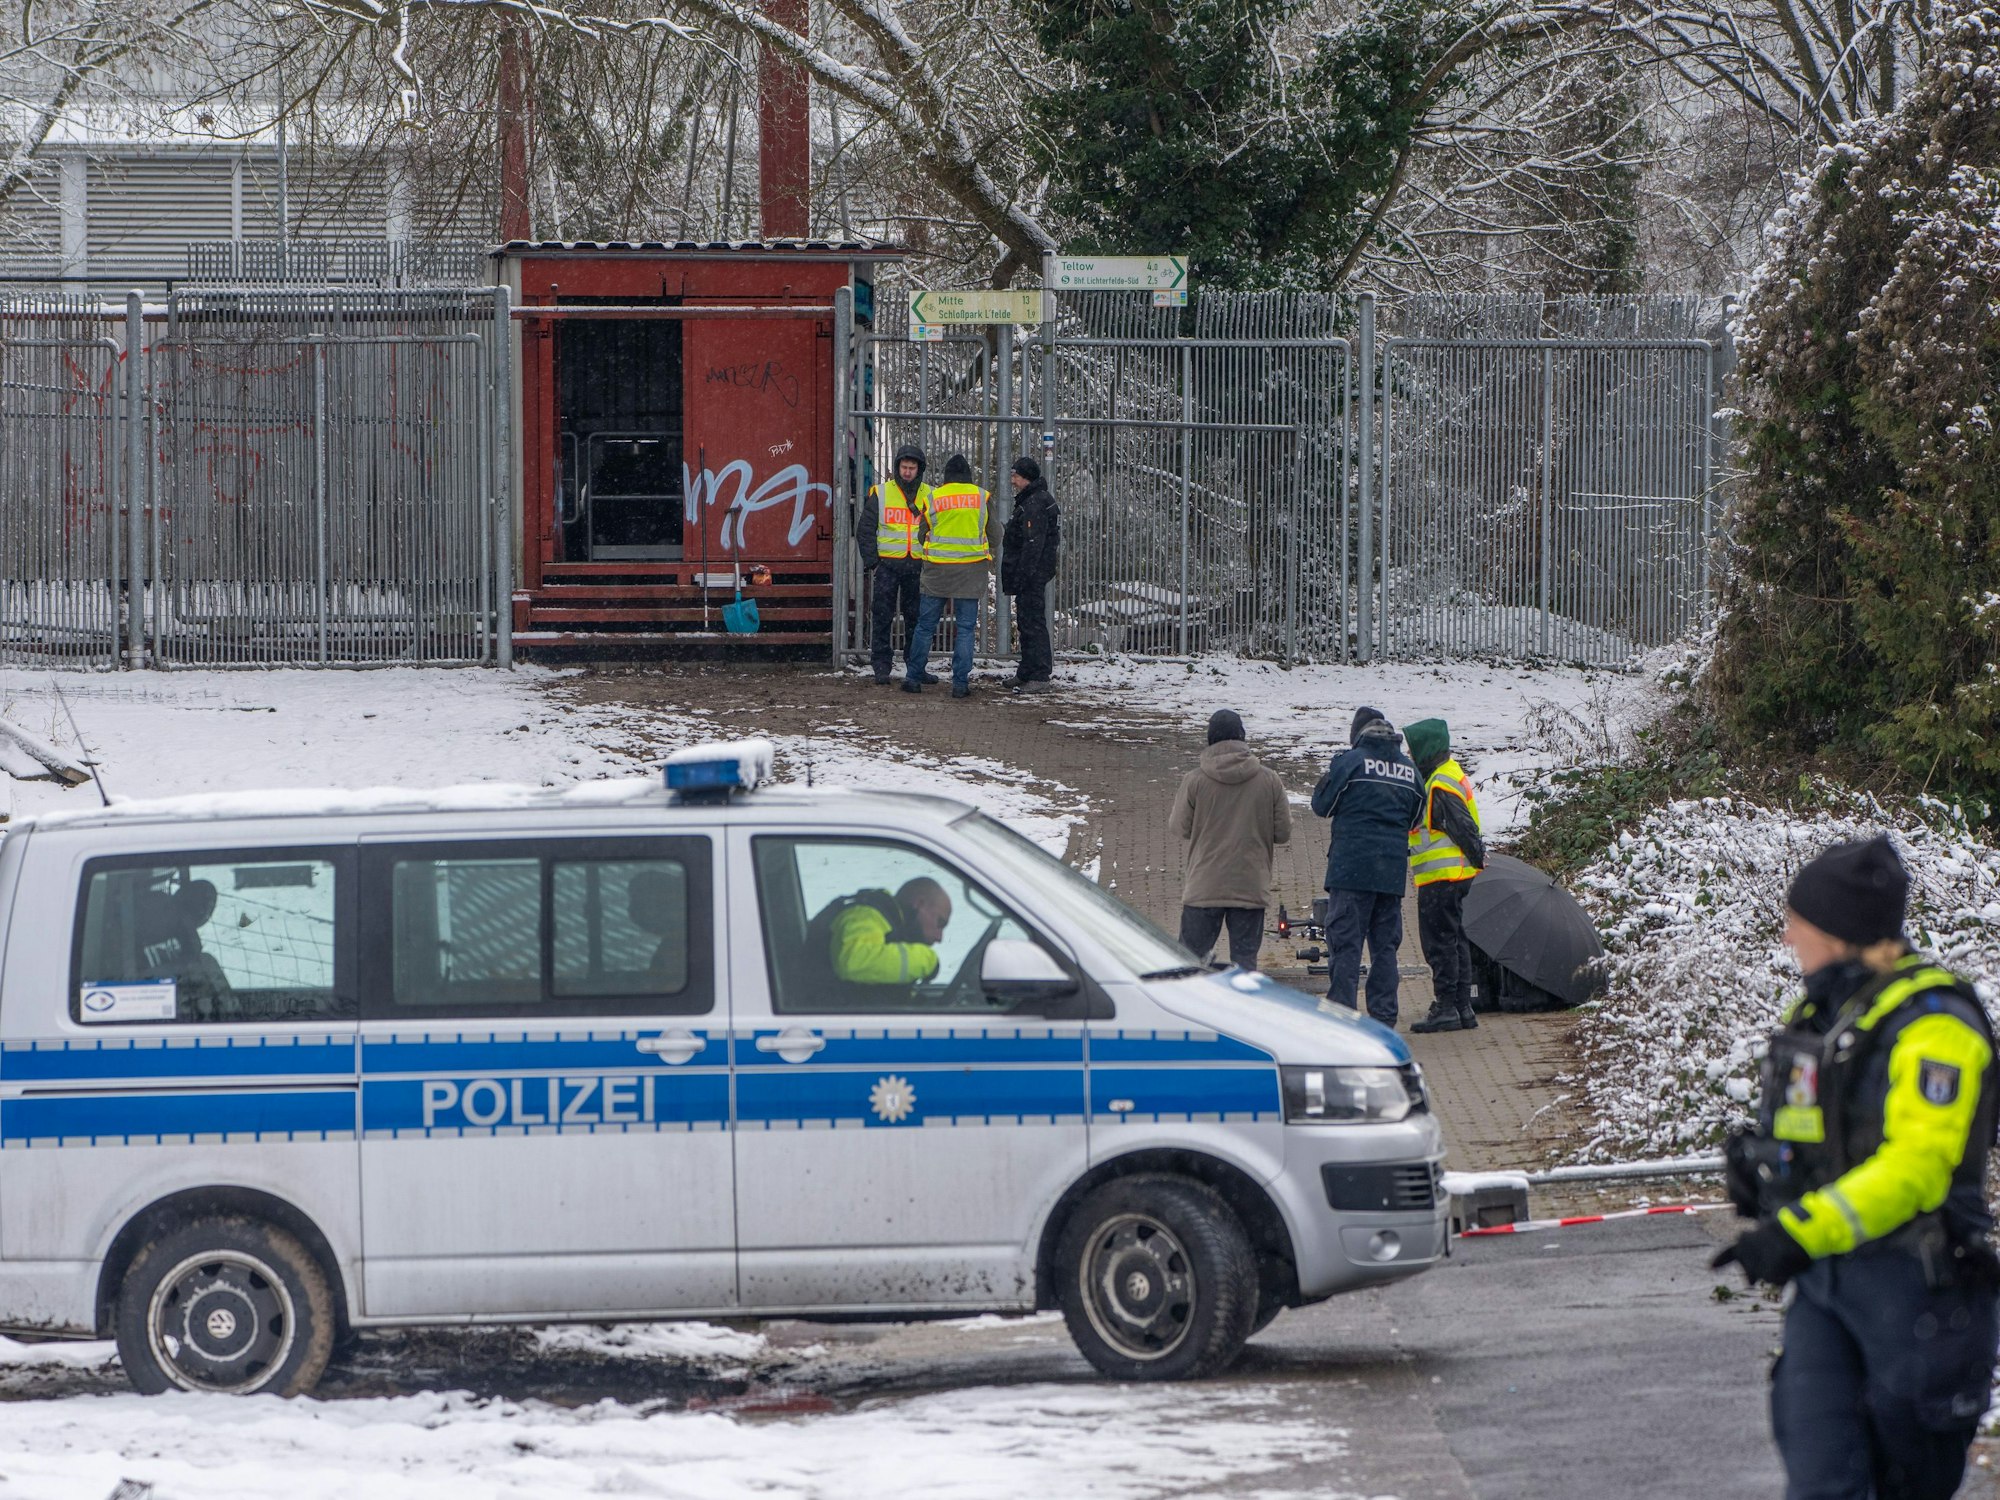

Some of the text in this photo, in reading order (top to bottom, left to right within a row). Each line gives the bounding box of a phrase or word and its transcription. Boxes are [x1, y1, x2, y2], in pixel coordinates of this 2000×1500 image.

[1061, 261, 1094, 271] Teltow
[1074, 276, 1085, 285] Bhf.
[1087, 276, 1139, 285] Lichterfelde-Süd
[938, 295, 1030, 306] Mitte 13
[939, 309, 982, 321] Schloßpark
[934, 495, 978, 511] POLIZEI
[886, 509, 921, 525] POLIZ
[1364, 758, 1415, 784] POLIZEI
[423, 1075, 655, 1127] POLIZEI
